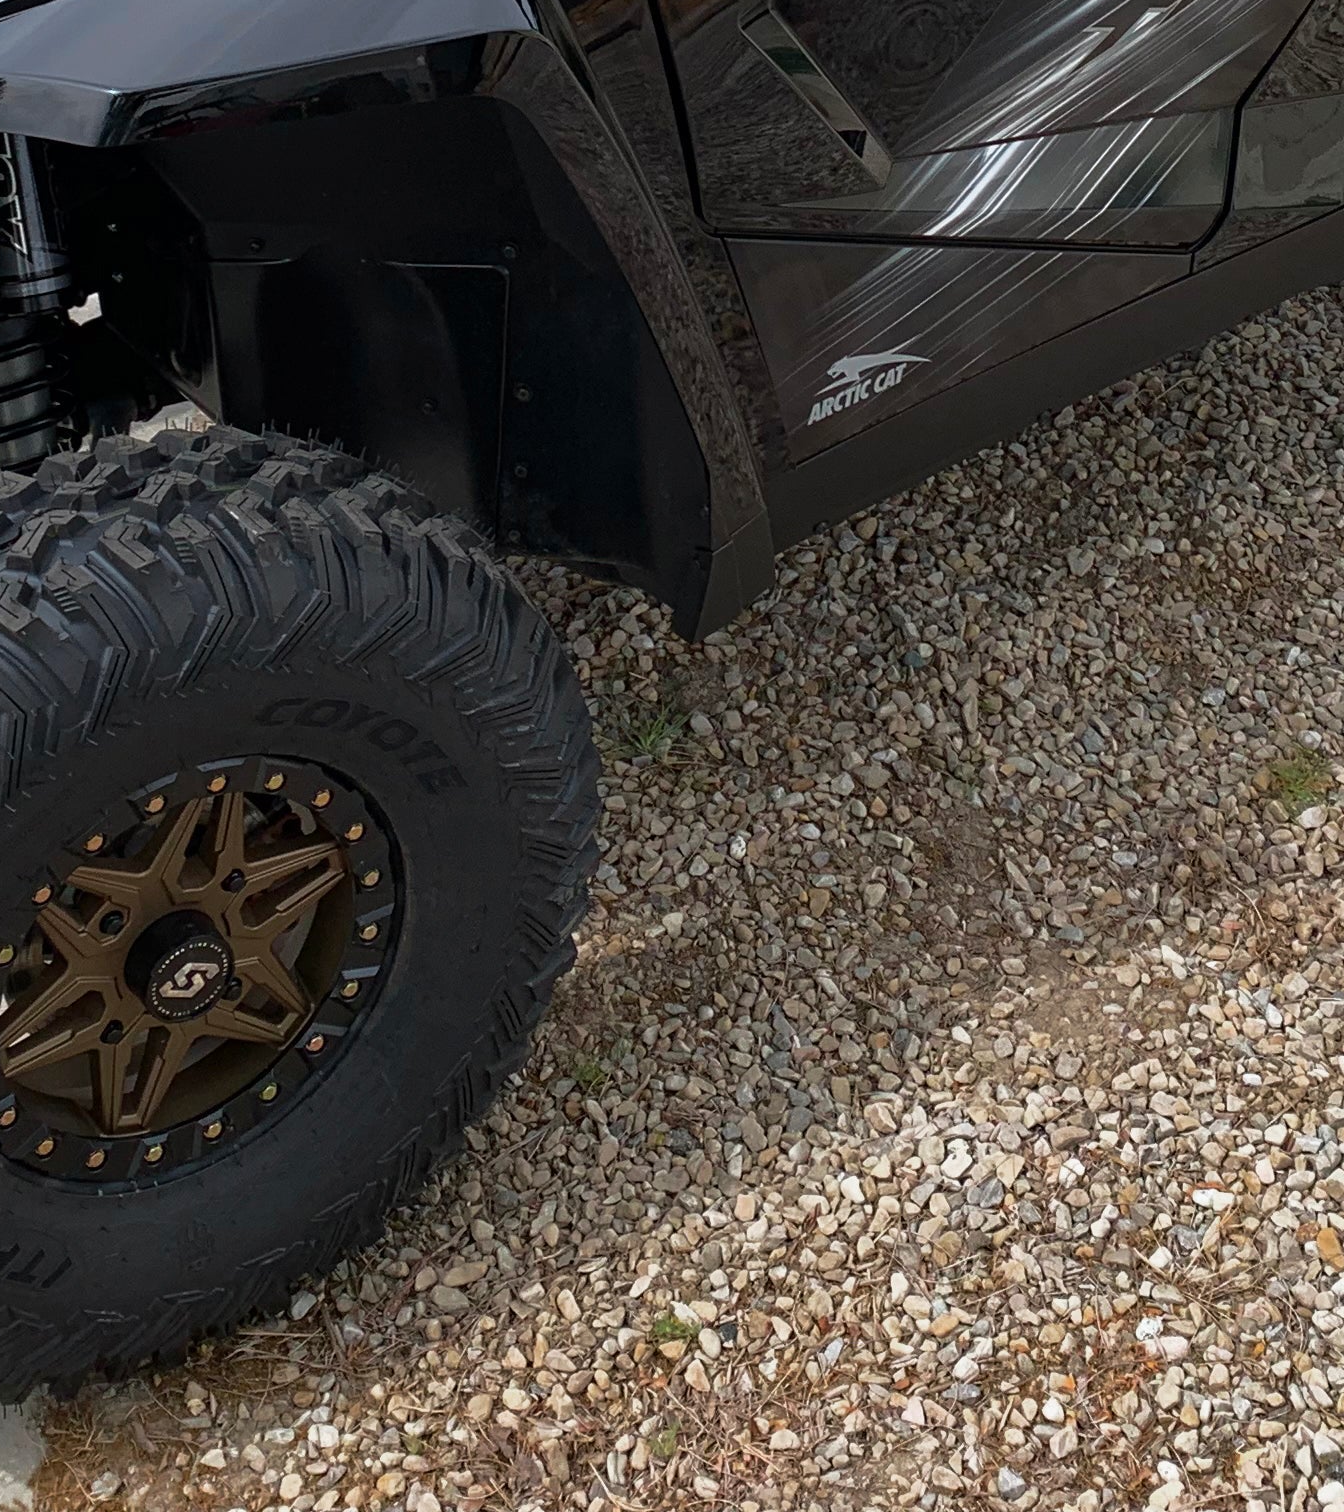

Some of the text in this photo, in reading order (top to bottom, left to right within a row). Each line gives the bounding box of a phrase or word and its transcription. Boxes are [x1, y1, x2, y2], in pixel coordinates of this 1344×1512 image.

[807, 362, 908, 426] ARCTIC CAT
[254, 697, 469, 795] COYOTE
